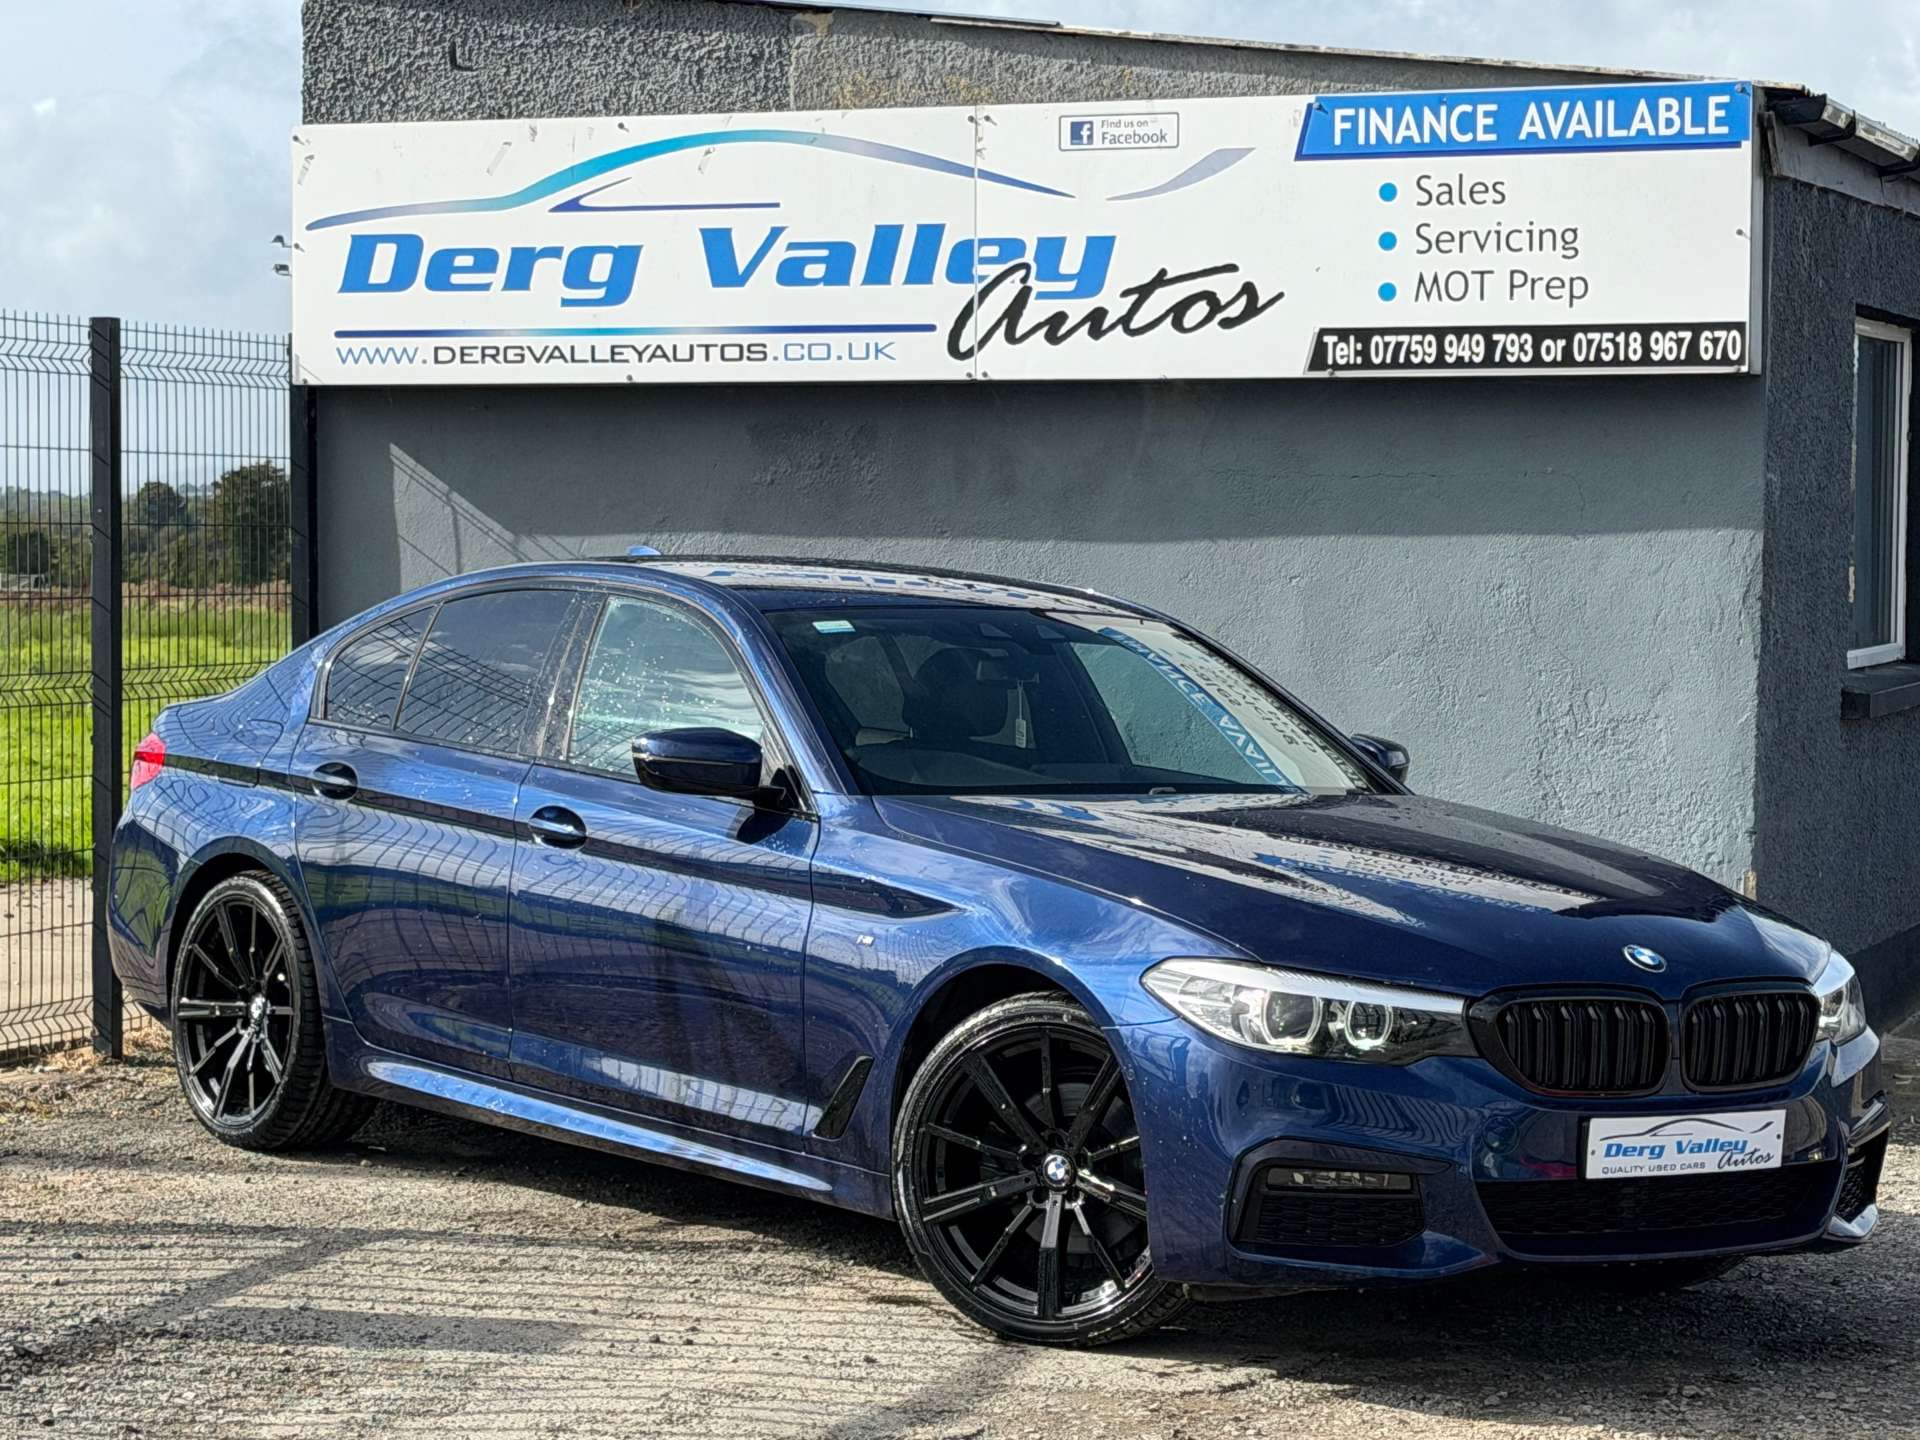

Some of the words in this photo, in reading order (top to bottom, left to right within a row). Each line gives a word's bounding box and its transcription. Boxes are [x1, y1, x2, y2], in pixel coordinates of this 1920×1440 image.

[1101, 120, 1121, 129] Find
[1136, 120, 1149, 128] on
[1101, 128, 1168, 145] Facebook
[1333, 103, 1498, 146] FINANCE
[1519, 95, 1731, 141] AVAILABLE
[1415, 174, 1506, 207] Sales
[1415, 221, 1580, 260] Servicing
[338, 233, 643, 307] Derg
[699, 223, 1117, 300] Valley
[1414, 269, 1495, 303] MOT
[1509, 269, 1589, 308] Prep
[1323, 334, 1363, 366] Tel:
[1370, 334, 1437, 364] 07759
[1444, 333, 1485, 363] 949
[1492, 332, 1534, 363] 793
[1541, 338, 1568, 362] or
[1573, 331, 1642, 362] 07518
[1649, 331, 1692, 361] 967
[1699, 330, 1742, 361] 670
[1604, 1142, 1666, 1160] Derg
[1675, 1138, 1748, 1155] Valley
[1717, 1148, 1775, 1170] Autos
[1601, 1165, 1645, 1175] QUALITY
[1648, 1164, 1677, 1172] USED
